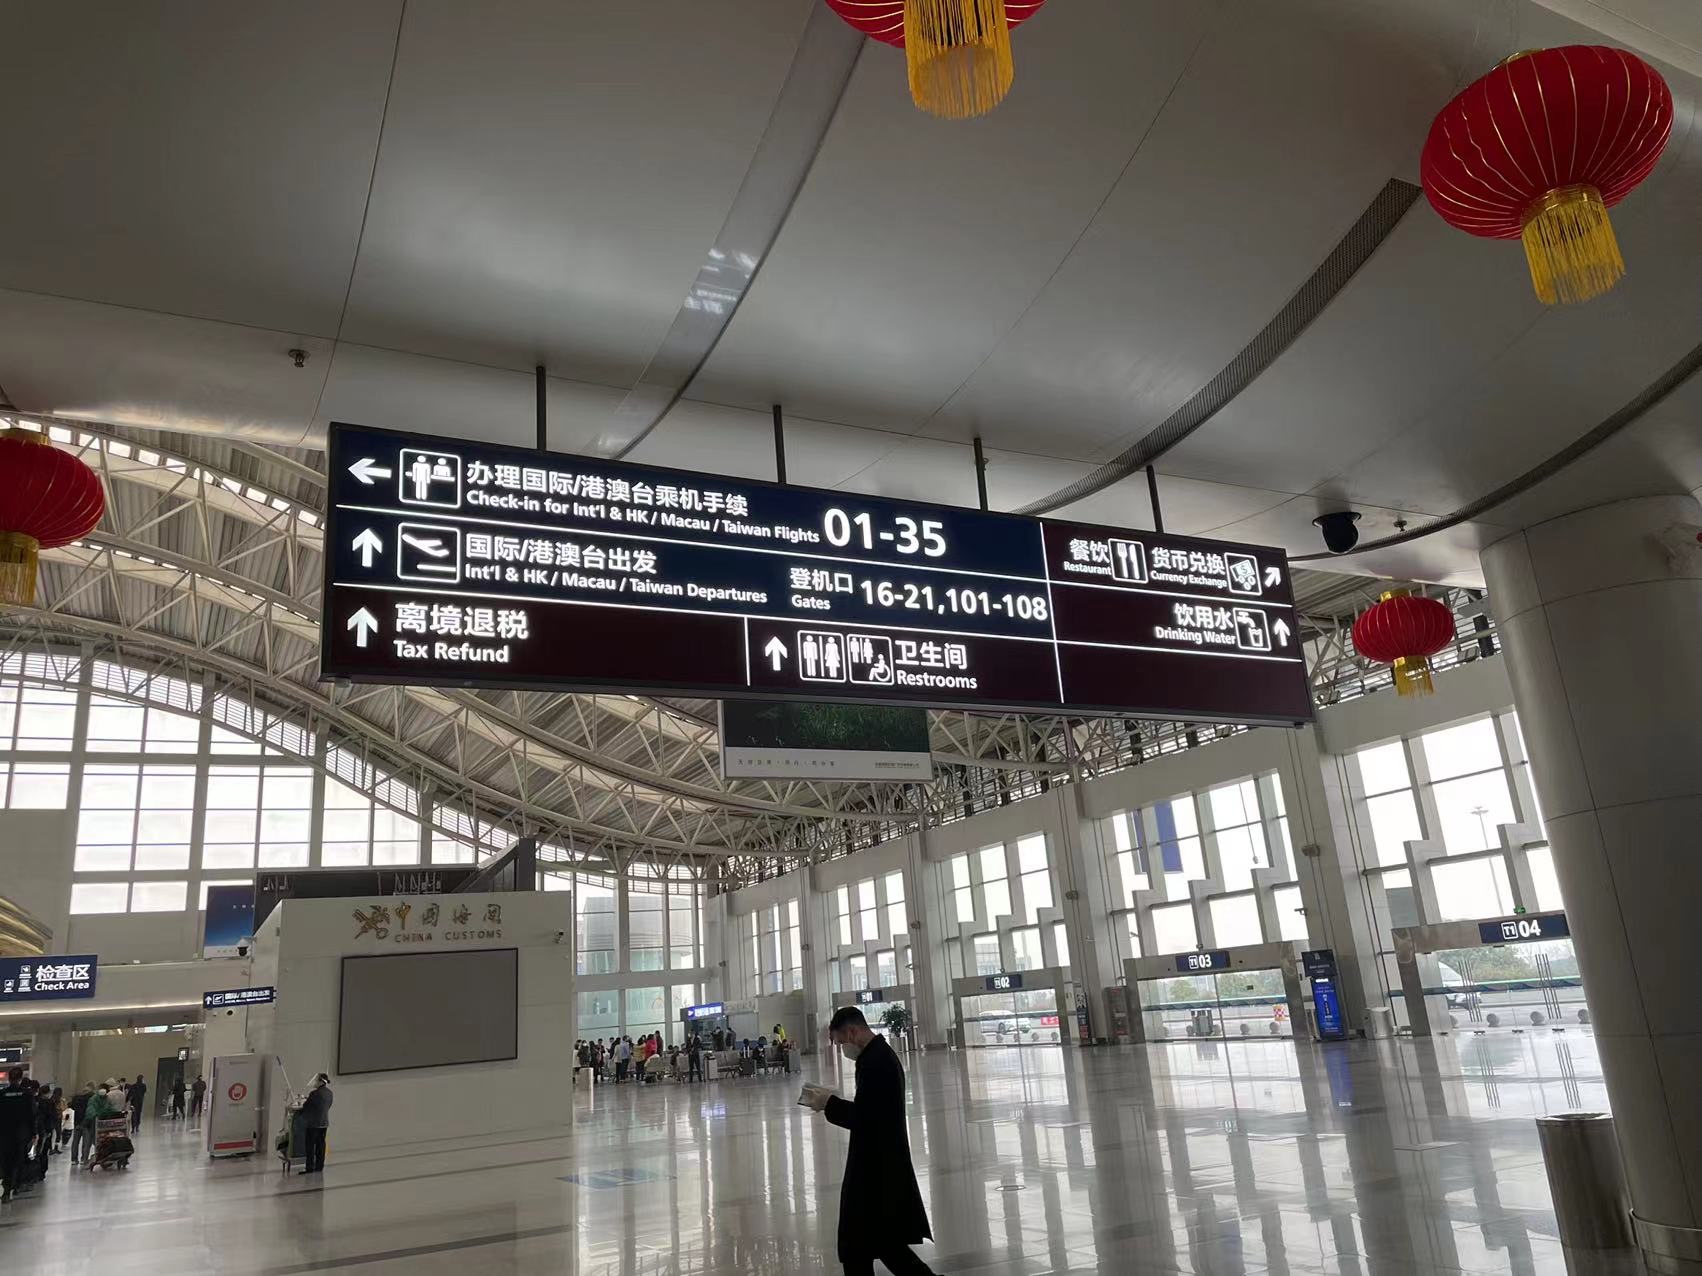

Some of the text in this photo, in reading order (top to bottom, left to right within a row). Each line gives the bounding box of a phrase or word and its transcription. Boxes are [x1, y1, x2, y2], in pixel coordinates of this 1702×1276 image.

[466, 460, 749, 518] 办理国际/港澳台乘机手续
[466, 490, 540, 511] Check-in
[544, 498, 569, 515] for
[609, 506, 622, 521] &
[626, 508, 649, 524] HK
[651, 511, 658, 526] /
[661, 512, 710, 531] Macau
[713, 518, 719, 532] /
[722, 519, 771, 538] Taiwan
[774, 525, 820, 543] Flights
[824, 508, 947, 557] 01-35
[465, 533, 657, 575] 国际/港澳台出发
[1069, 538, 1111, 564] 餐饮
[1151, 546, 1226, 576] 货币兑换
[790, 567, 854, 594] 登机口
[1063, 561, 1112, 576] Restaurant
[1150, 570, 1228, 589] Currency Exchange
[505, 567, 519, 582] &
[524, 569, 549, 585] HK
[551, 571, 558, 586] /
[562, 572, 616, 590] Macau
[619, 577, 627, 592] /
[629, 578, 683, 596] Taiwan
[687, 583, 768, 604] Departures
[791, 594, 831, 611] Gates
[860, 580, 1048, 621] 16-21,101-108
[395, 602, 529, 640] 离境退税
[1173, 602, 1235, 630] 饮用水
[1154, 626, 1236, 645] Drinking Water
[393, 639, 509, 663] Tax Refund
[894, 640, 968, 670] 卫生间
[896, 669, 978, 690] Restrooms
[394, 929, 503, 943] CHINA CUSTOMS
[1518, 919, 1541, 938] 04
[36, 964, 91, 982] 检查区
[1198, 954, 1212, 968] 03
[34, 981, 65, 991] Check
[66, 981, 90, 990] Area
[1000, 976, 1010, 988] 02
